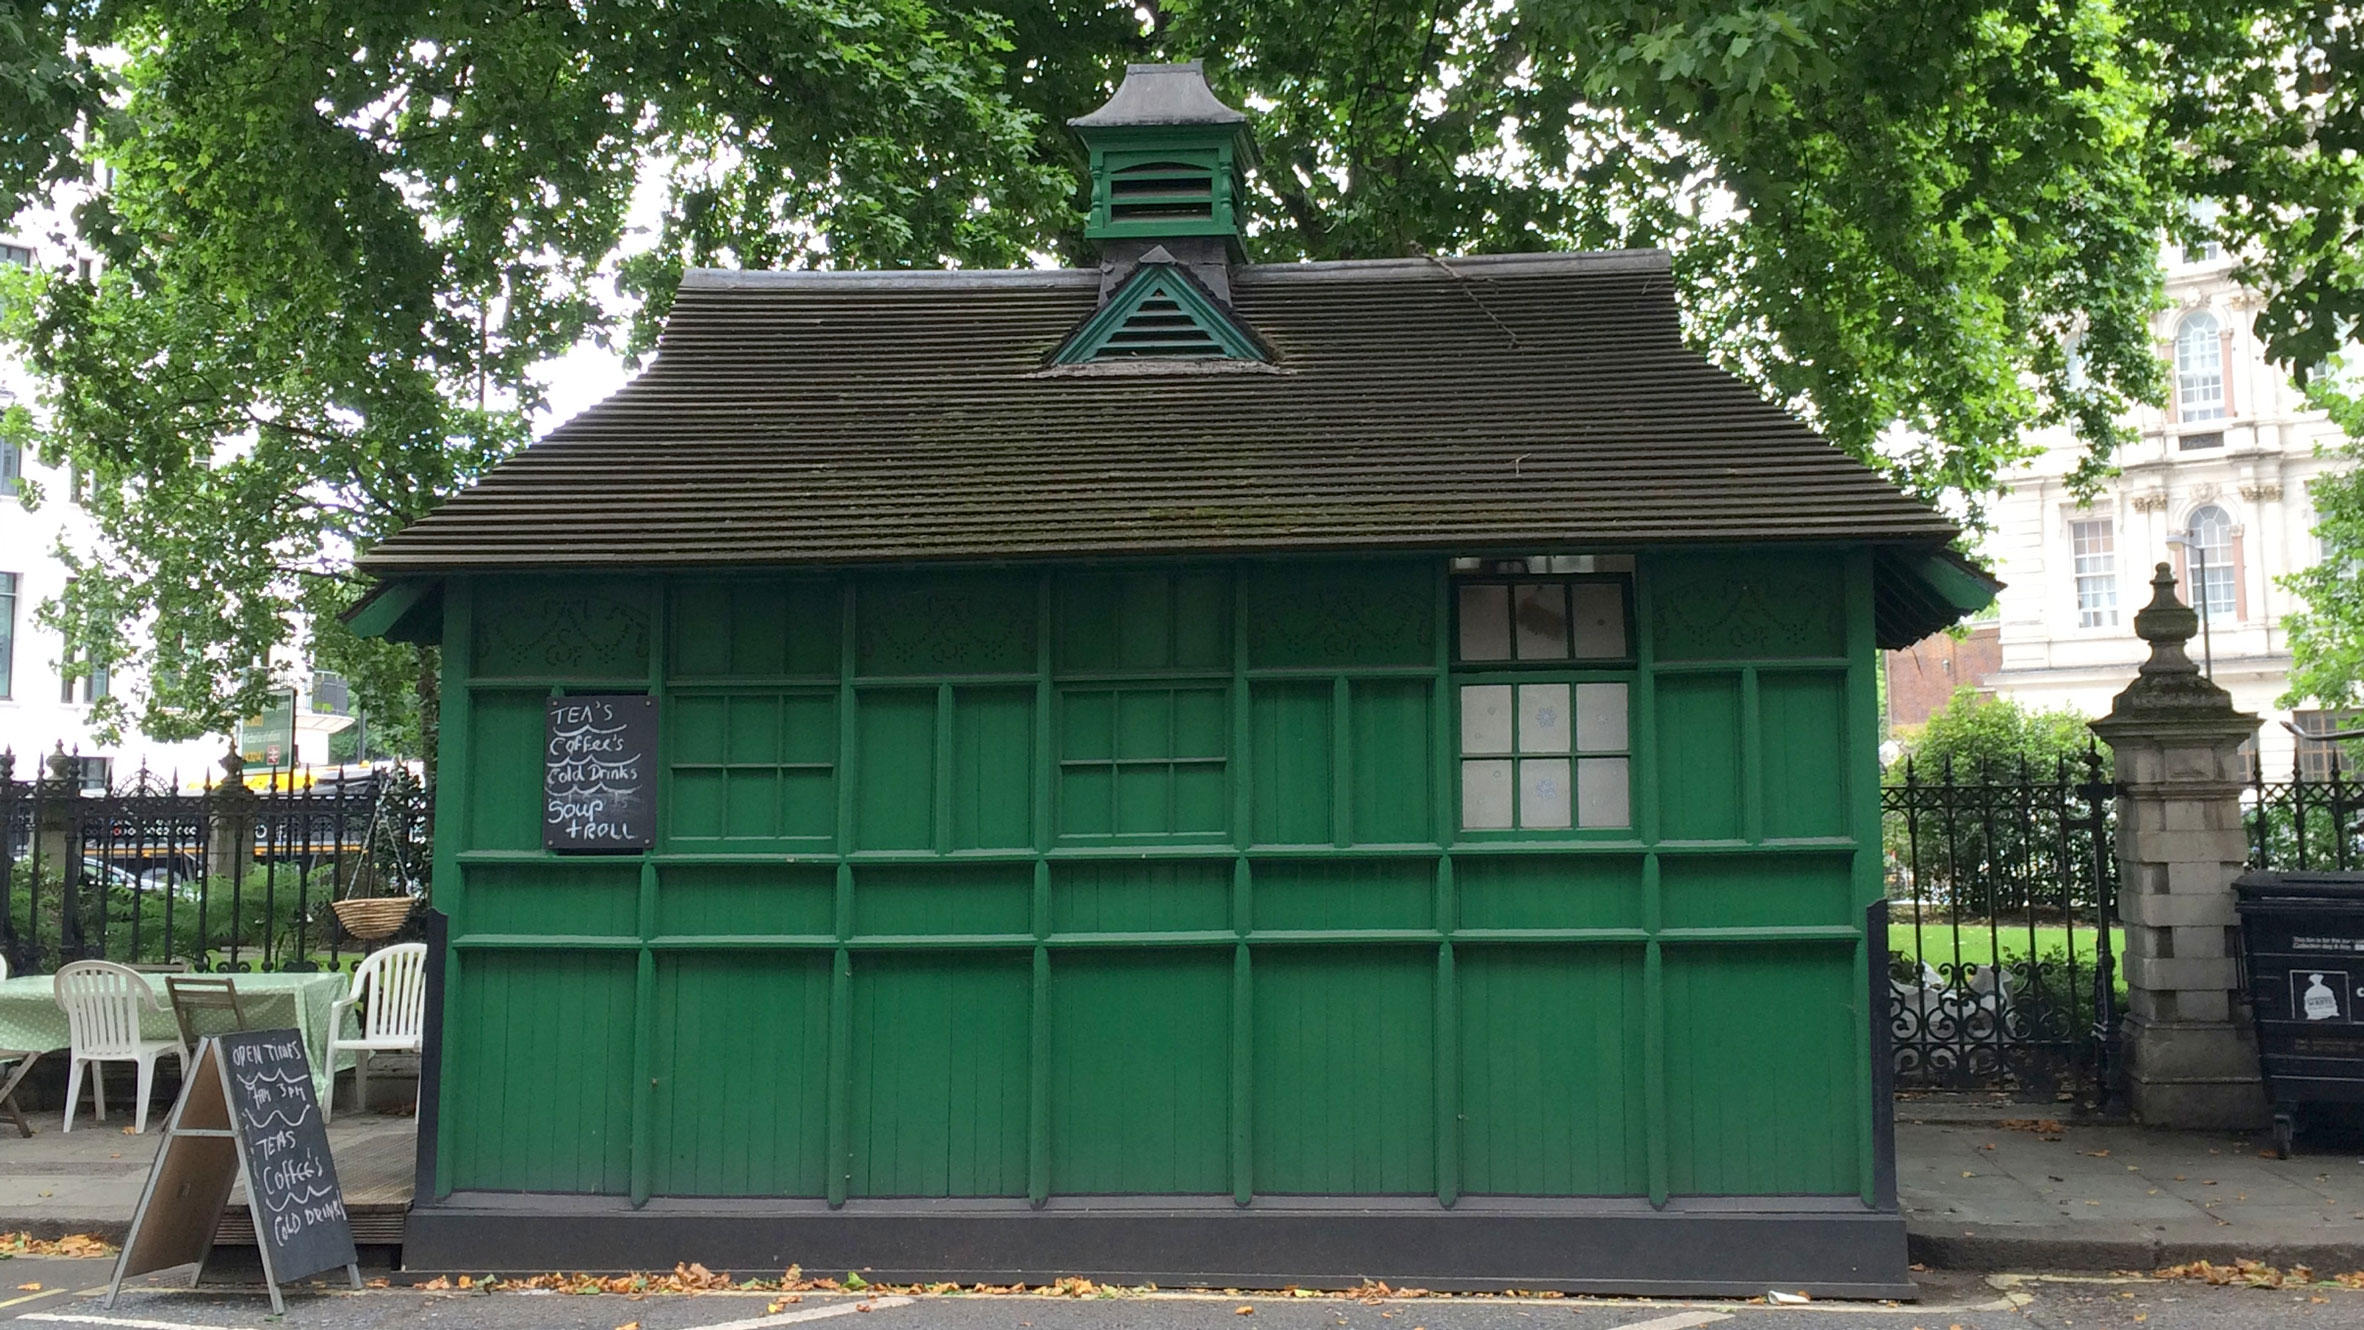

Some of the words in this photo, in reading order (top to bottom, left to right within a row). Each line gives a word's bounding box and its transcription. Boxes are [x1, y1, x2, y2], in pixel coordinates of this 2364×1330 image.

[547, 764, 585, 785] Cold
[548, 799, 604, 824] Soup
[233, 1044, 264, 1068] OPEN
[255, 1130, 297, 1161] TEAS
